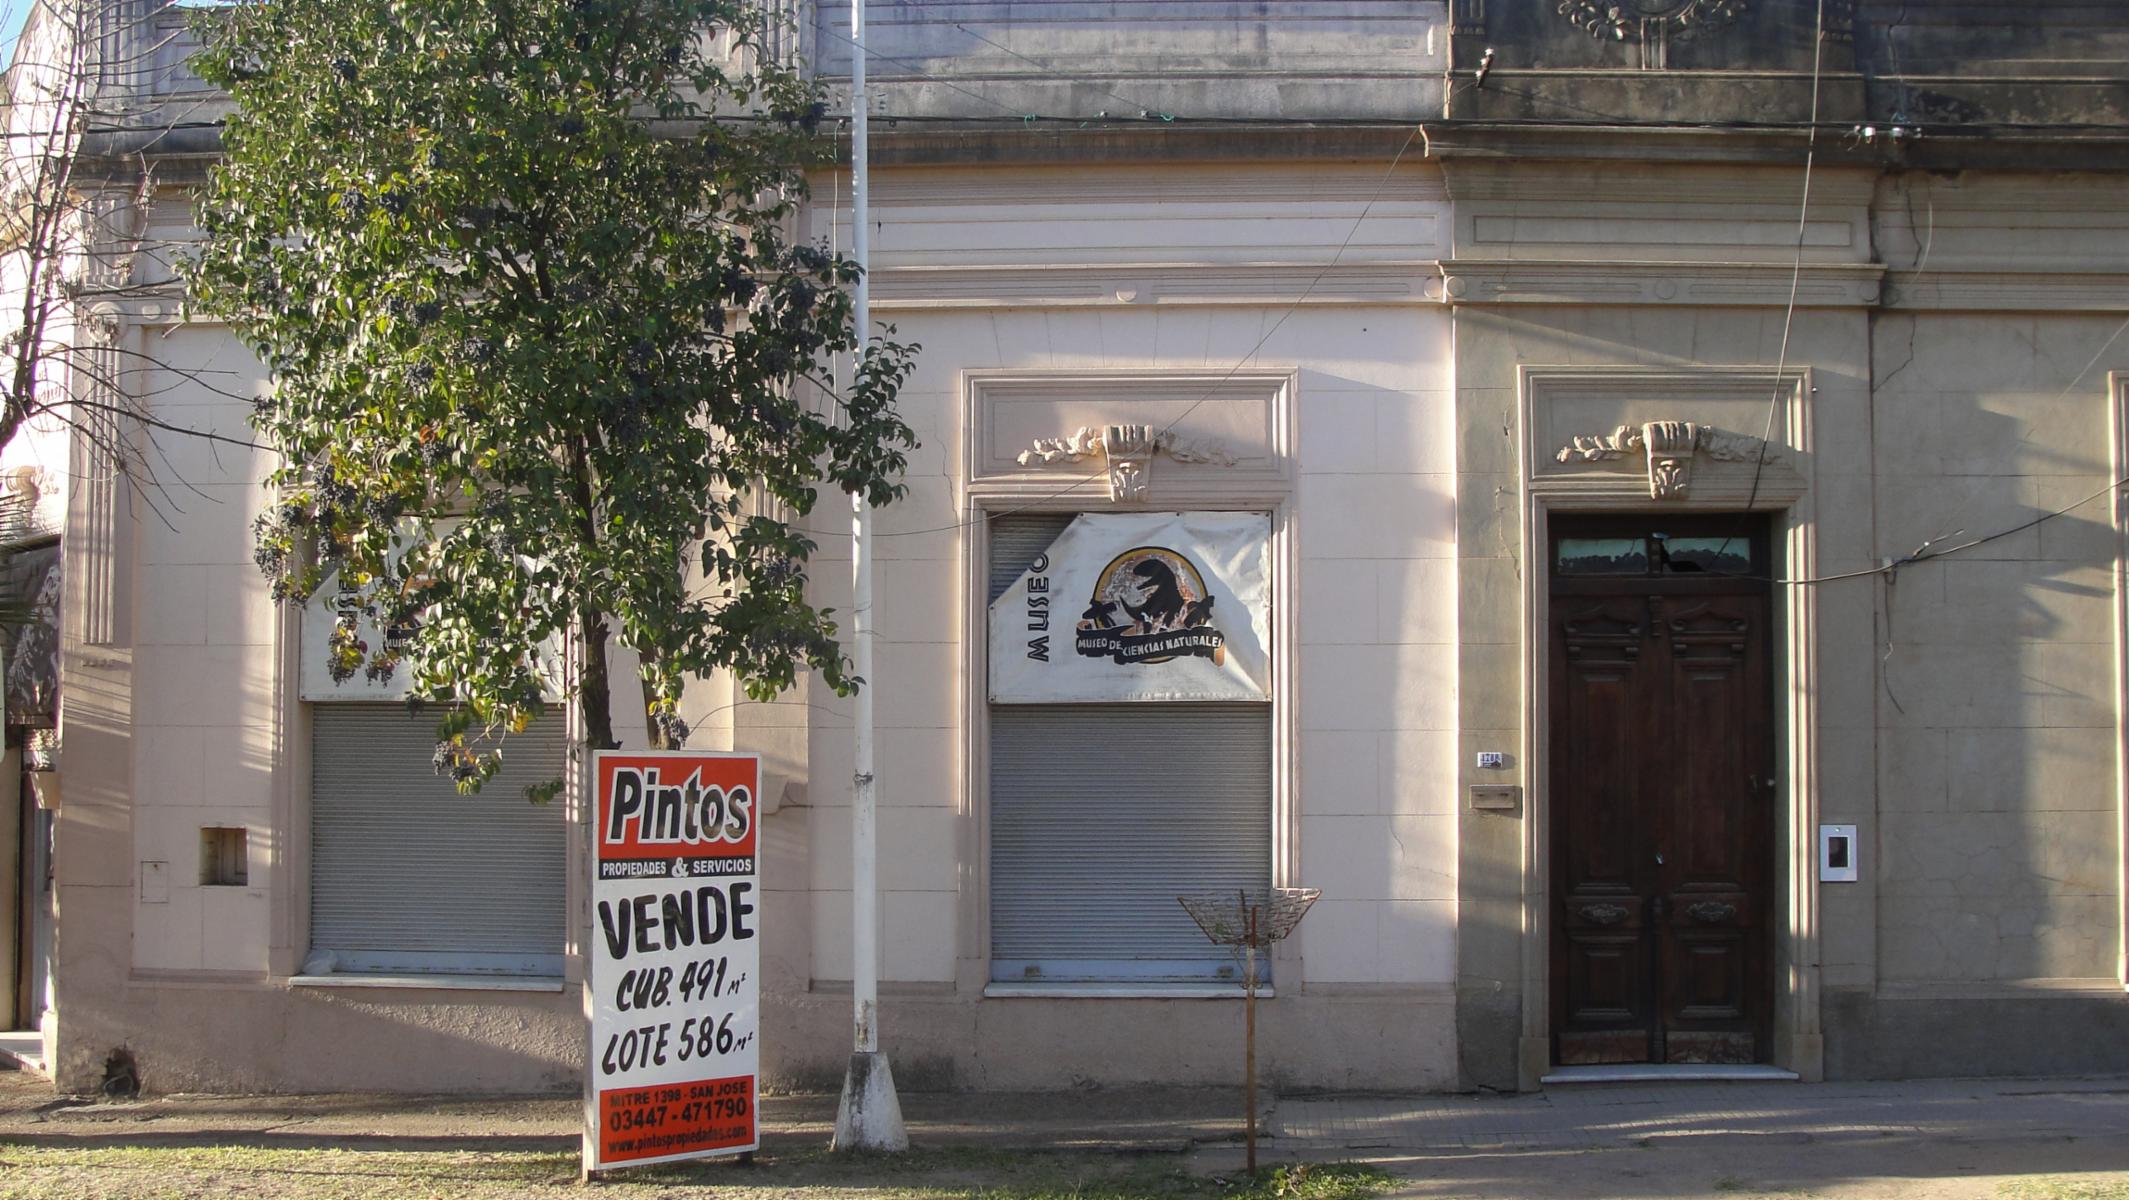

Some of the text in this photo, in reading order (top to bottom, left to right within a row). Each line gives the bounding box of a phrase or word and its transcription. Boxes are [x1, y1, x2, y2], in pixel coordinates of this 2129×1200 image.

[1027, 553, 1050, 663] MUSEO
[1077, 635, 1223, 657] MUSEO DE CIENCIAS NATURALES
[605, 765, 752, 844] Pintos
[602, 857, 752, 878] PROPIEDADES & SERVICIOS
[598, 882, 754, 960] VENDE
[679, 956, 728, 1003] 491
[601, 1022, 671, 1075] LOTE
[678, 1012, 734, 1061] 586
[609, 1106, 668, 1132] 03447
[681, 1097, 747, 1122] 471790
[610, 1091, 650, 1107] MITRE
[654, 1088, 681, 1104] 1398
[690, 1085, 713, 1100] SAN
[717, 1081, 747, 1096] JOSE
